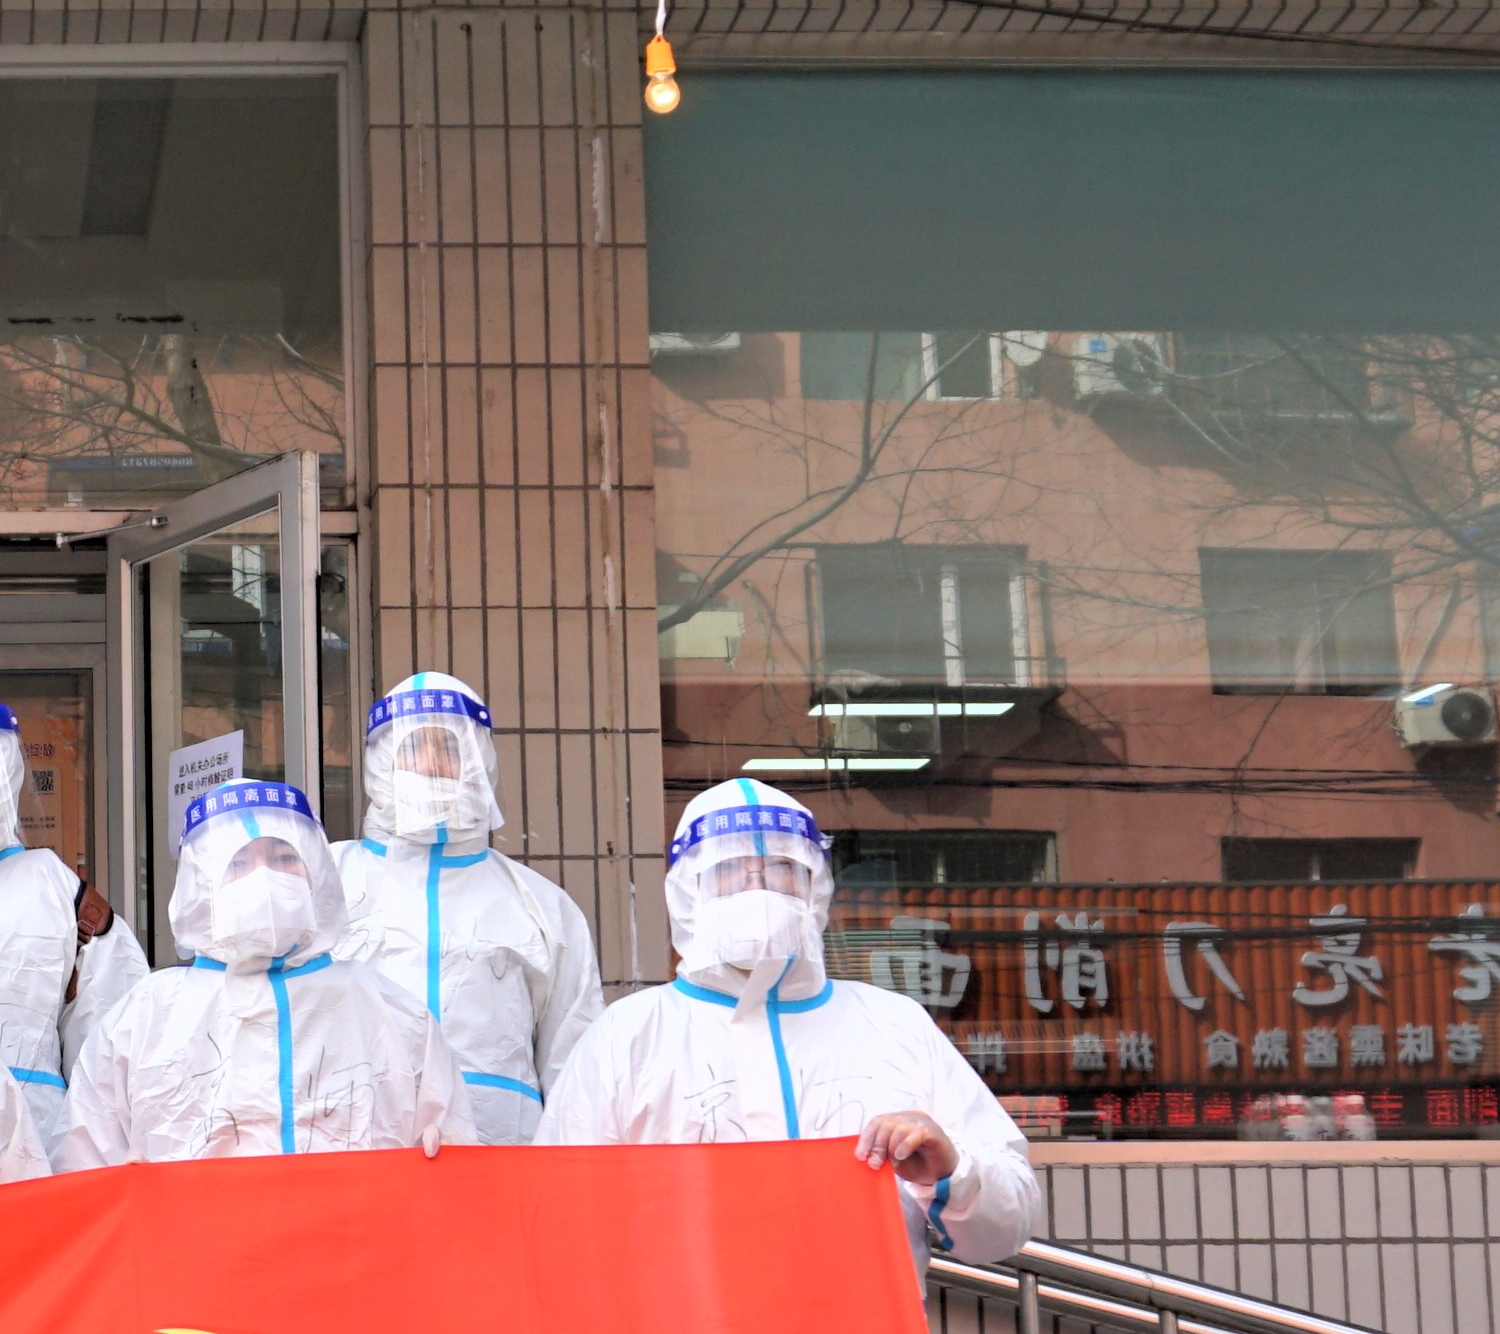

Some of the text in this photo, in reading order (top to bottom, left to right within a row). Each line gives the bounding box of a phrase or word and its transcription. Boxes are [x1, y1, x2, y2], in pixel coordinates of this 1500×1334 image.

[191, 787, 298, 823] 医用隔离面罩
